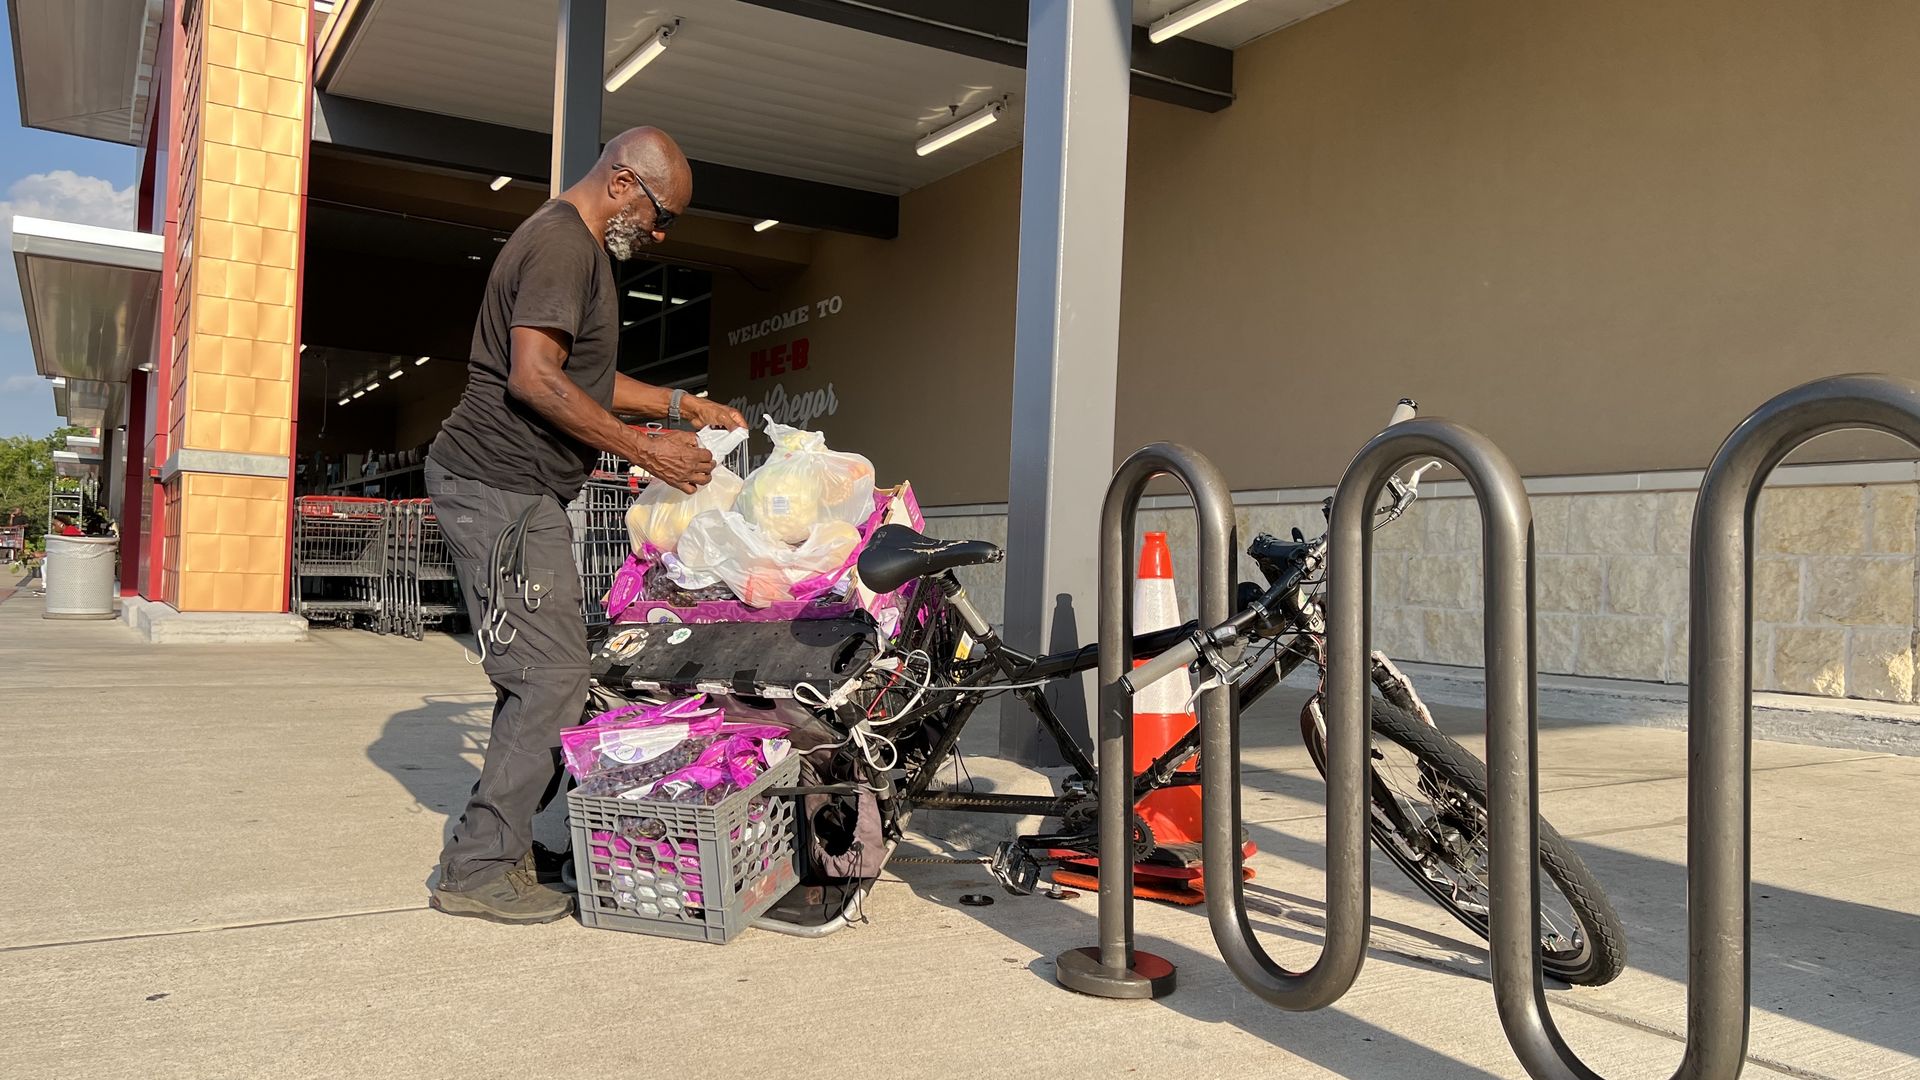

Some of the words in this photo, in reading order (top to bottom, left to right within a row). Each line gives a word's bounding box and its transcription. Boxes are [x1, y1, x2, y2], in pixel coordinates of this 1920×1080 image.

[728, 305, 809, 347] WELCOME
[816, 295, 843, 319] TO
[750, 338, 810, 380] H-E-B
